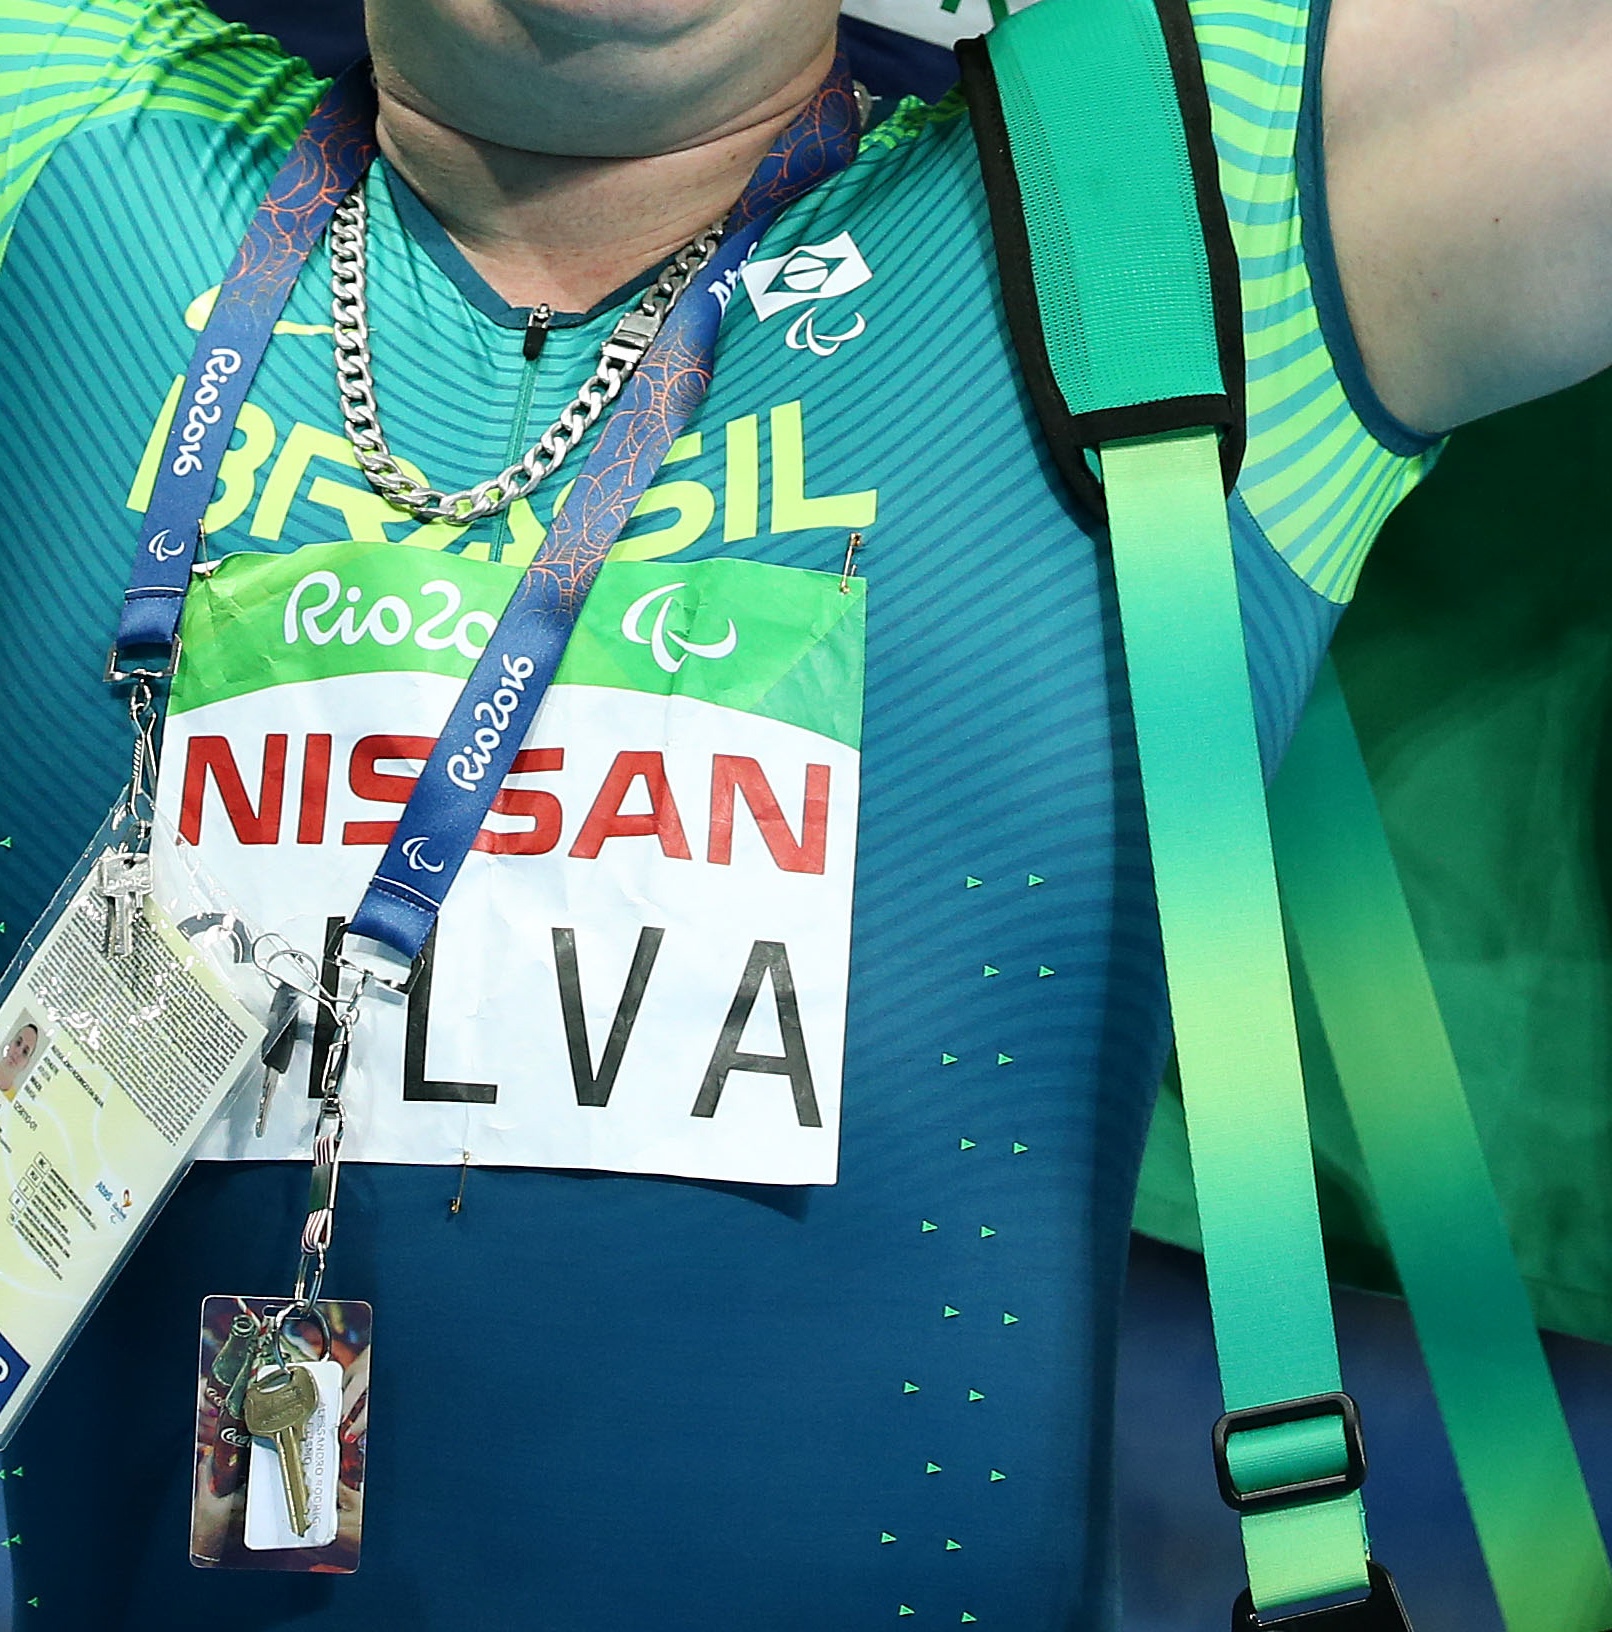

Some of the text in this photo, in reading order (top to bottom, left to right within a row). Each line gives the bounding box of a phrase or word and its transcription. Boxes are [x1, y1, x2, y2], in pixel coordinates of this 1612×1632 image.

[172, 348, 242, 477] Rio2016
[446, 653, 536, 792] Rio2016
[178, 732, 832, 875] NISSAN
